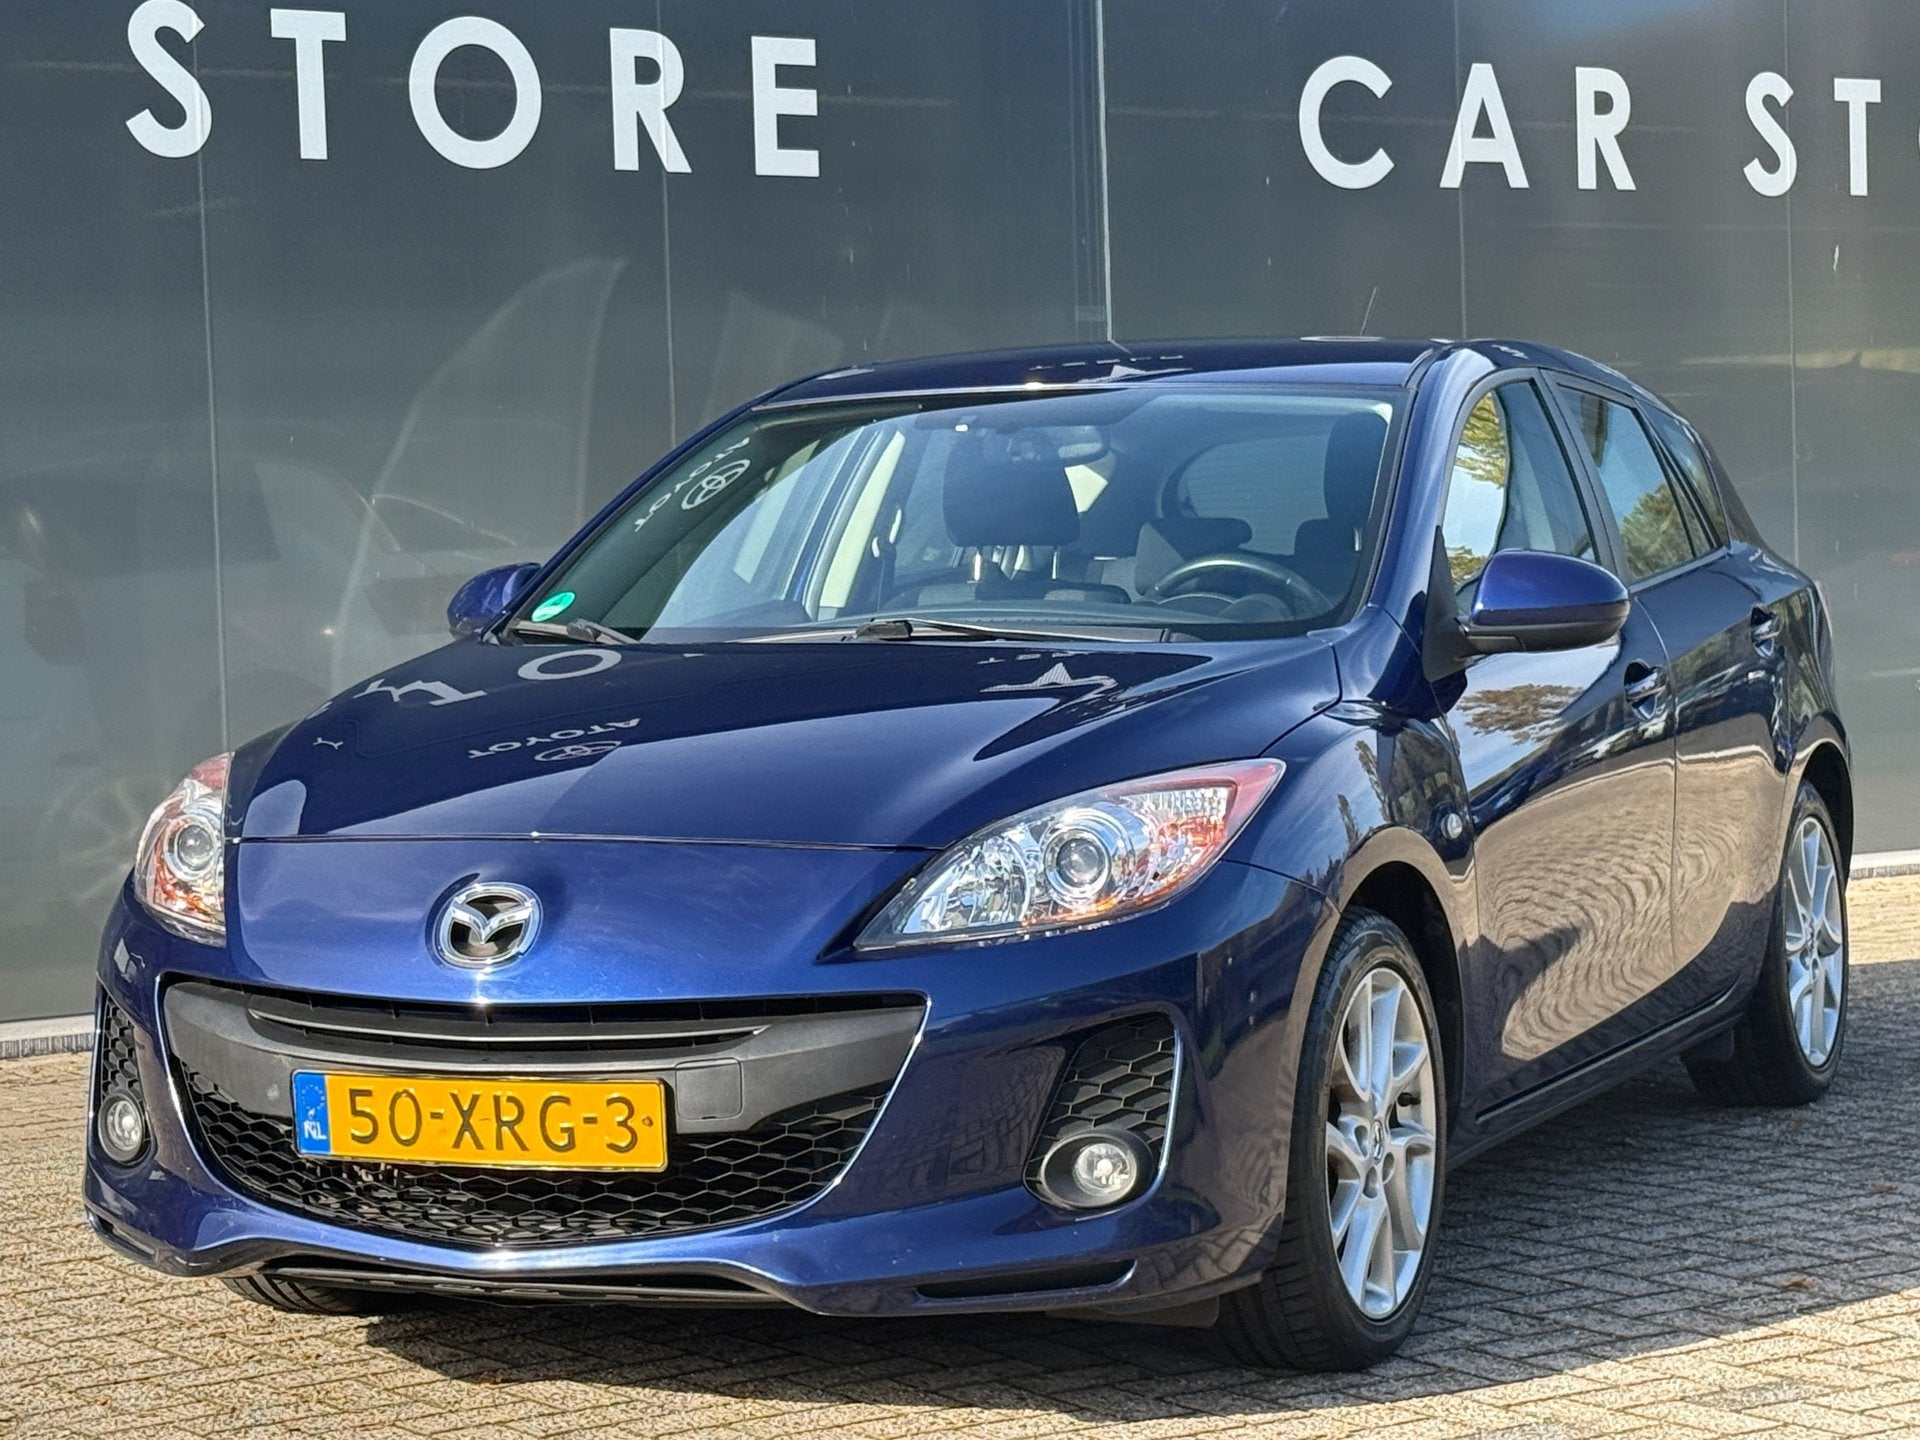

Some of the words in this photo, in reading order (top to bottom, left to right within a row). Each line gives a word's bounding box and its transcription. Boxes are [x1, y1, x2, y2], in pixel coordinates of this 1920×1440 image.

[125, 0, 820, 177] STORE
[1298, 55, 1637, 190] CAR
[1743, 71, 1920, 197] ST
[303, 1120, 328, 1140] NL
[348, 1087, 638, 1153] 50-XRG-3
